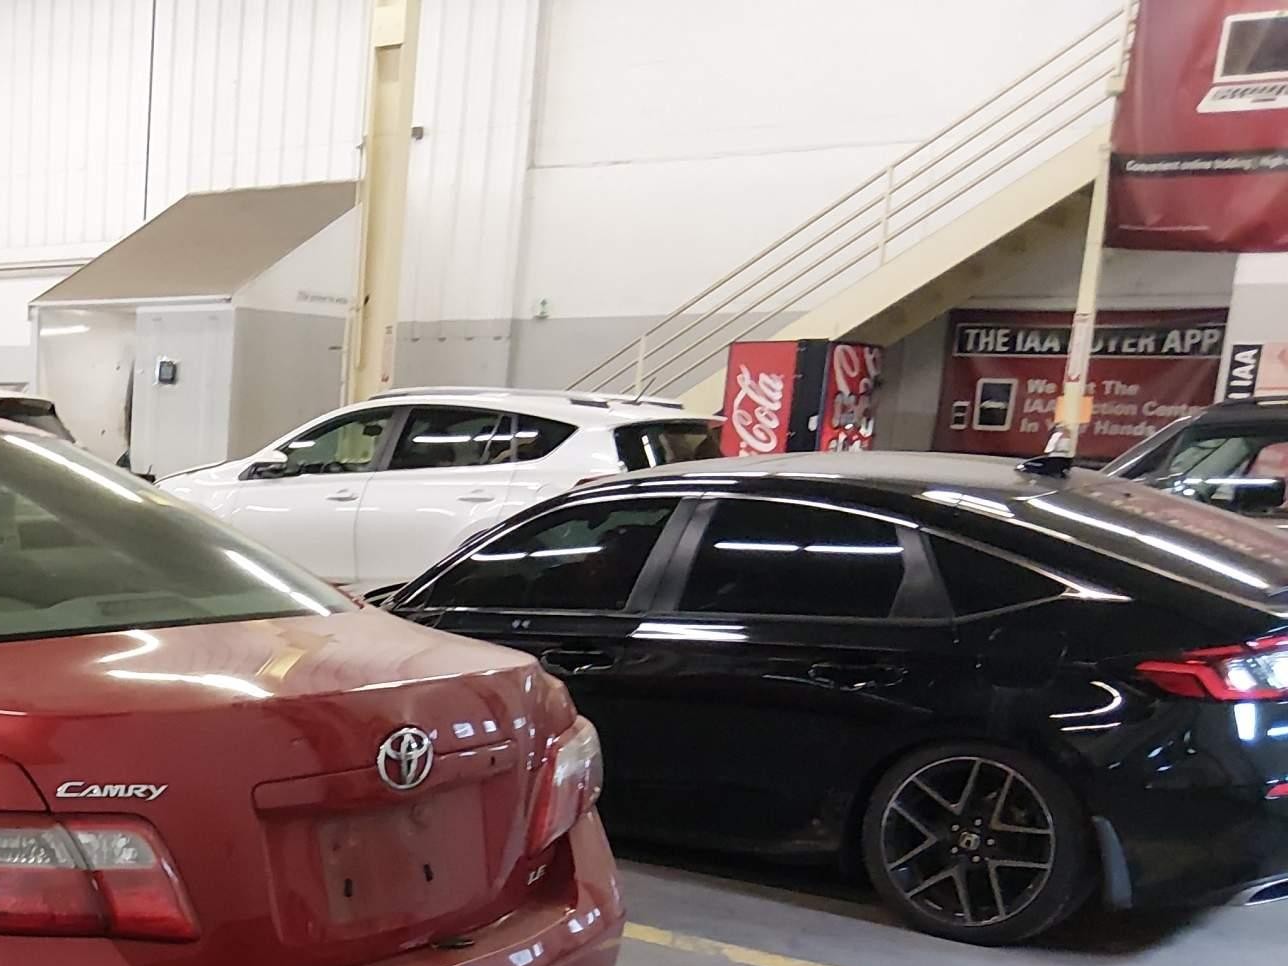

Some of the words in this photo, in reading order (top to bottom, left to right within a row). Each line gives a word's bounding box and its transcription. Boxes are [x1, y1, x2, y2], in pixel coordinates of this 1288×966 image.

[964, 329, 1010, 352] THE
[1015, 330, 1061, 352] IAA
[1089, 332, 1158, 353] UYER
[1160, 329, 1221, 353] APP
[1027, 379, 1057, 394] We
[1102, 380, 1140, 396] The
[1019, 418, 1039, 433] In
[55, 781, 169, 801] CAMRY
